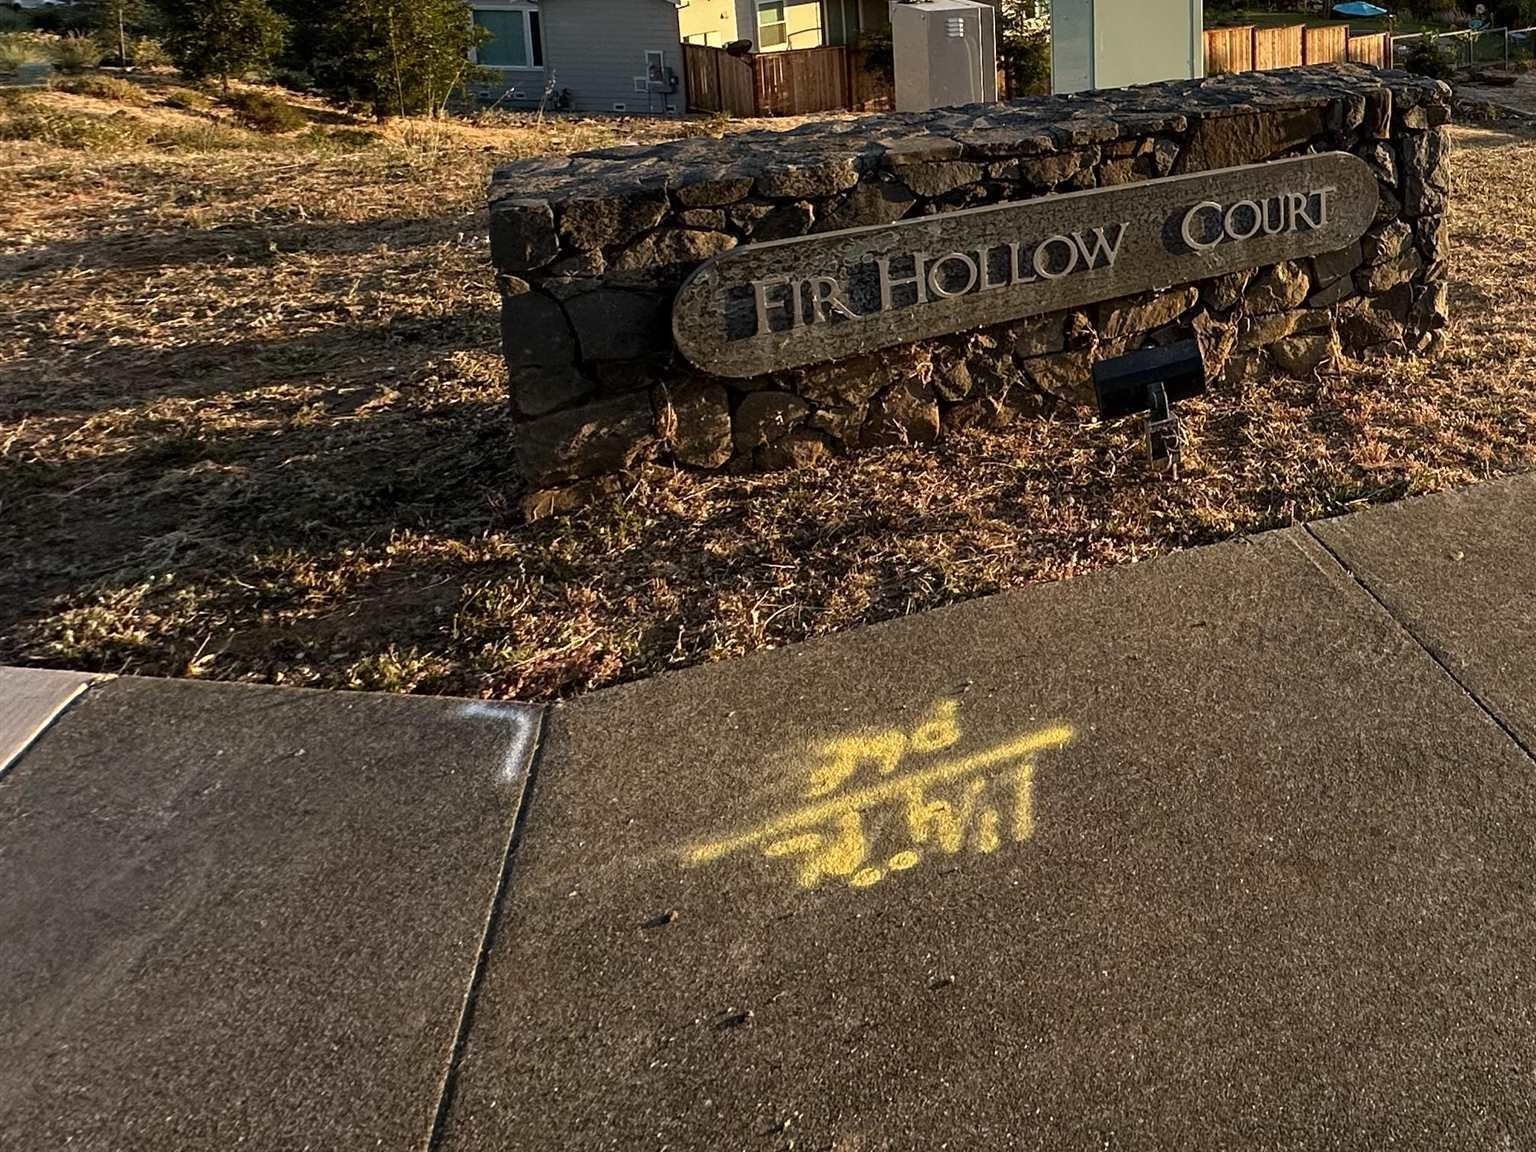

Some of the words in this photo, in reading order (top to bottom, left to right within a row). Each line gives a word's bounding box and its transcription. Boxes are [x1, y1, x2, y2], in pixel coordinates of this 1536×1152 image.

[751, 274, 865, 334] FIR
[876, 222, 1130, 311] HOLLOW
[1181, 186, 1337, 250] COURT
